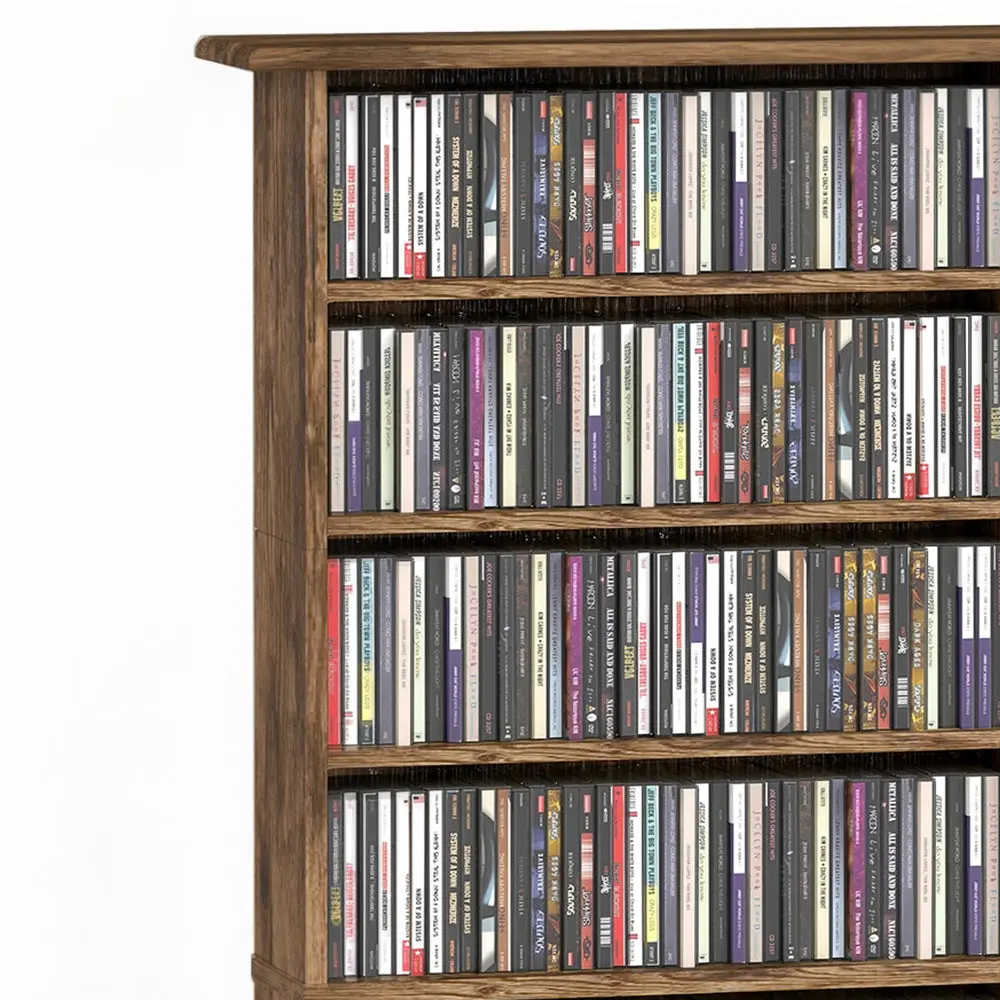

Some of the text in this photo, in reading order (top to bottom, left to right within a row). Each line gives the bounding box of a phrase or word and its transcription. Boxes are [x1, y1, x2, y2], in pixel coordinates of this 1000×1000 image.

[890, 93, 898, 132] METALLICA
[452, 137, 460, 158] SYSTEM
[890, 143, 898, 156] ALL
[452, 160, 460, 168] OF
[650, 156, 658, 173] TOWN
[890, 166, 898, 183] SAID
[452, 176, 460, 191] DOWN
[890, 185, 898, 200] AND
[890, 201, 898, 221] DONE
[606, 556, 614, 688] METALLICA ALL IS SAID AND DONE
[888, 782, 896, 821] METALLICA
[888, 832, 896, 845] ALL
[888, 855, 896, 872] SAID
[888, 874, 896, 889] AND
[888, 890, 896, 910] DONE
